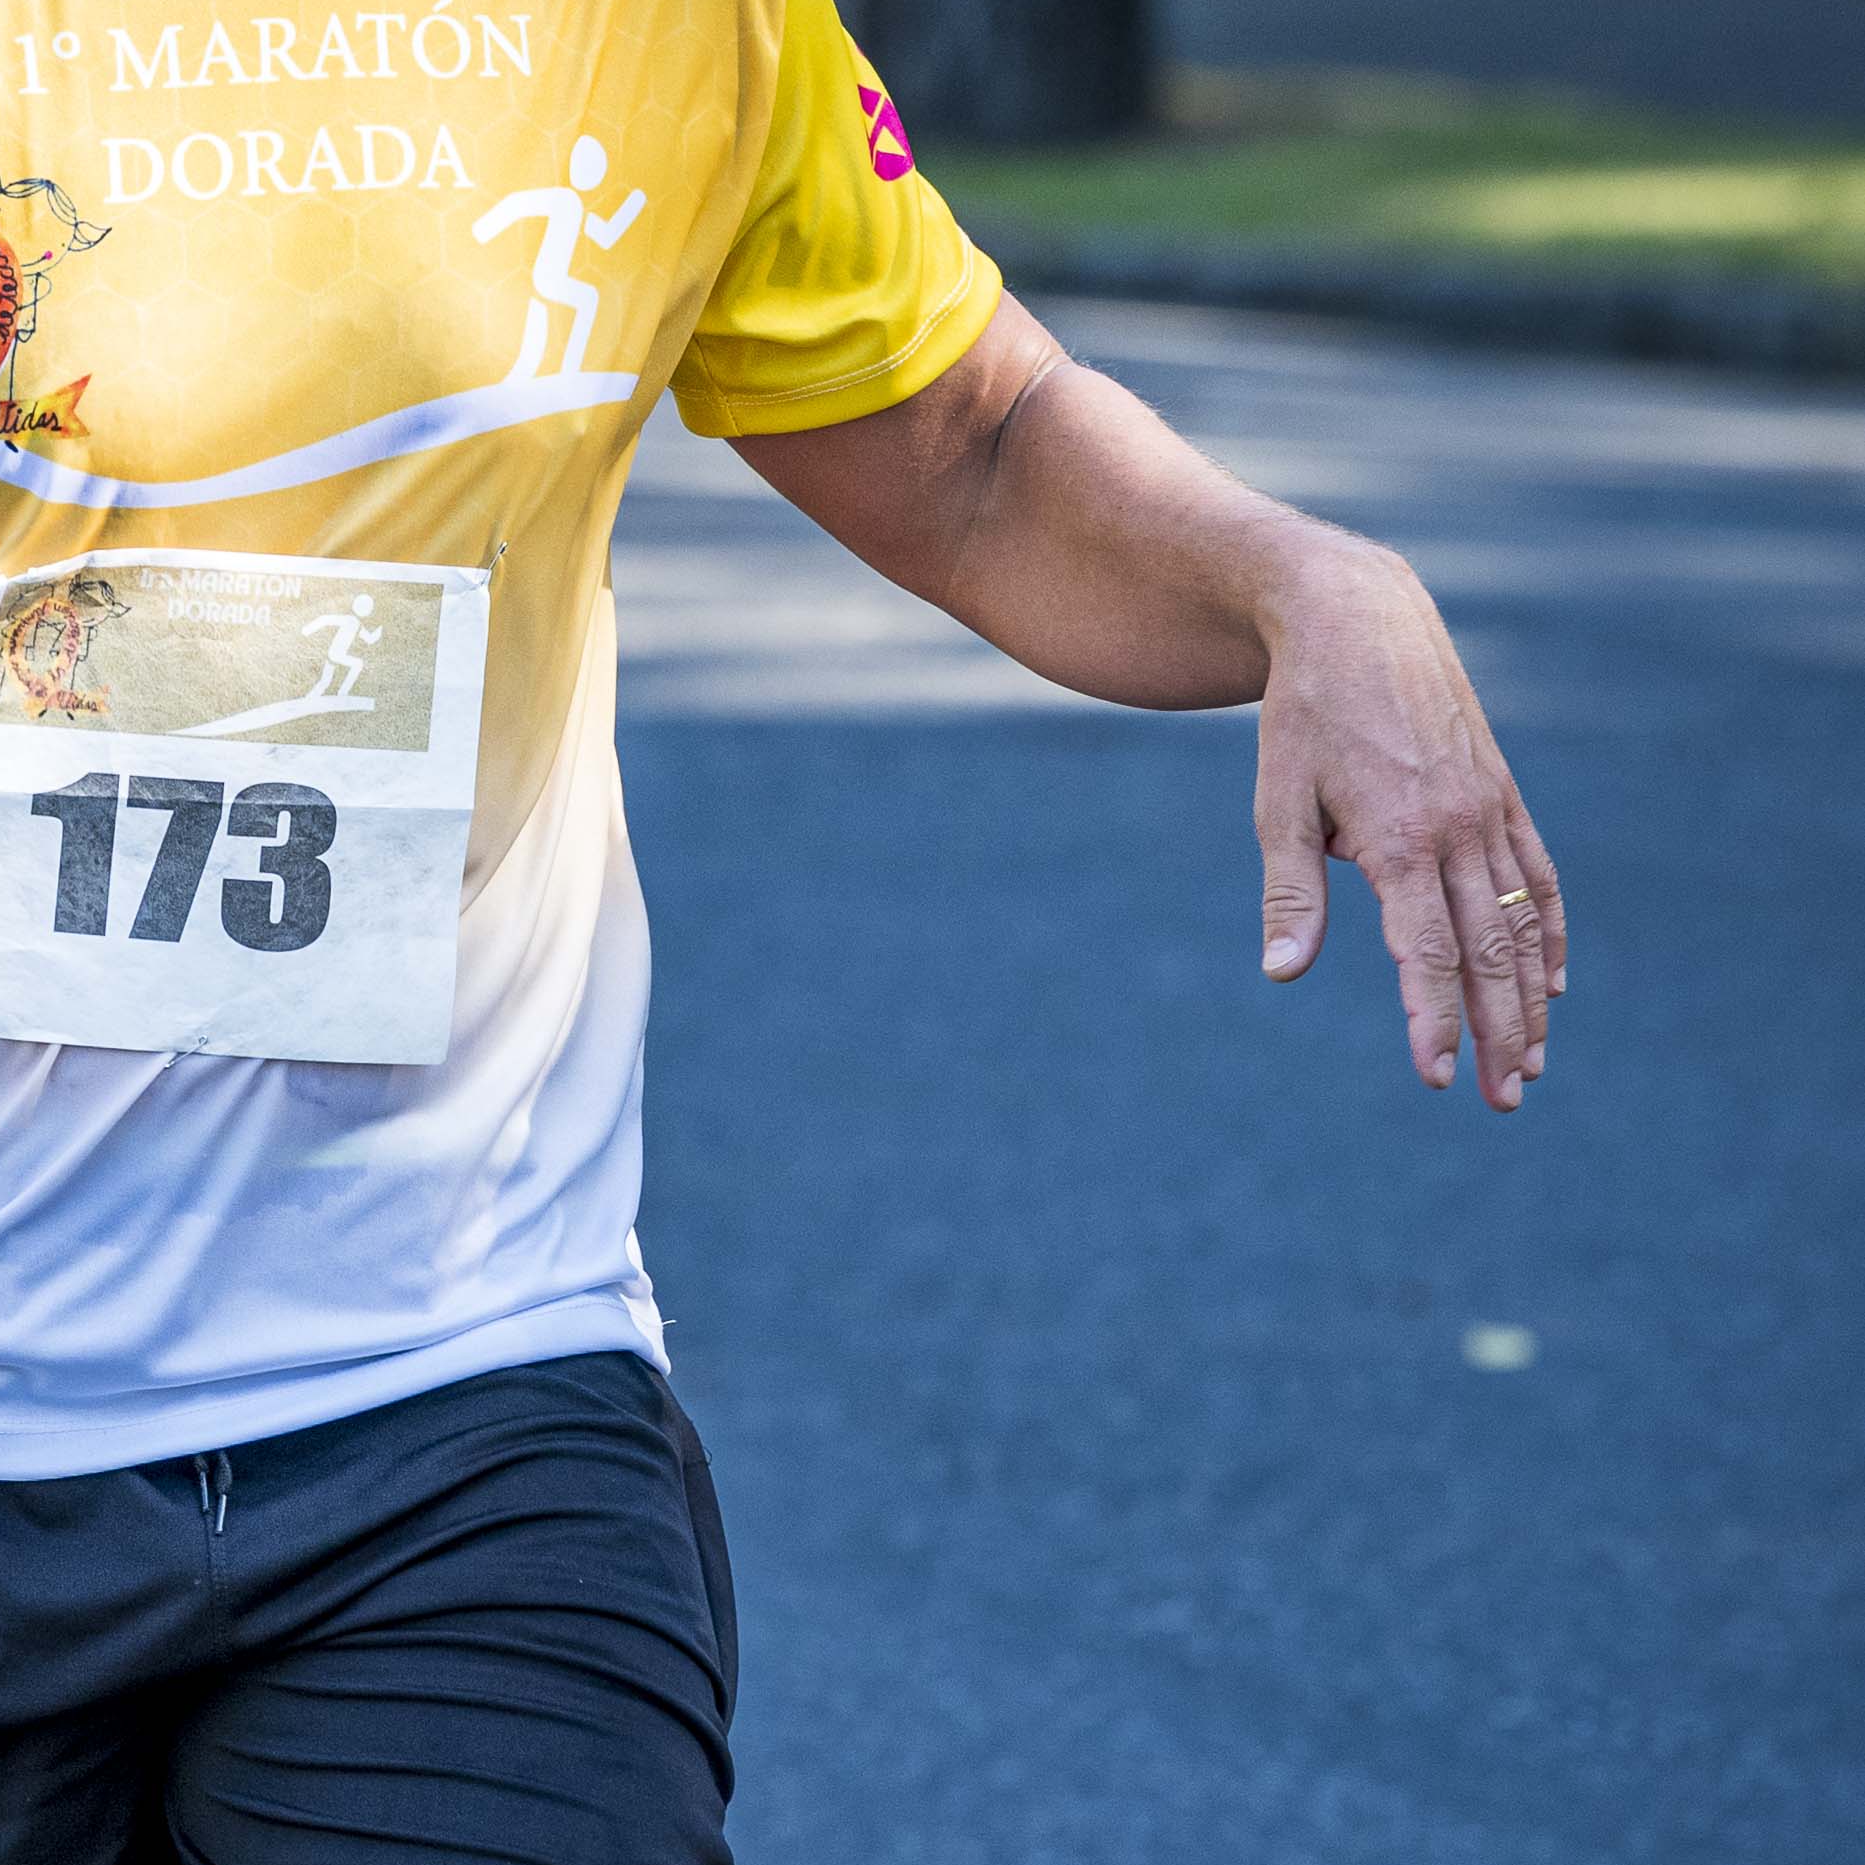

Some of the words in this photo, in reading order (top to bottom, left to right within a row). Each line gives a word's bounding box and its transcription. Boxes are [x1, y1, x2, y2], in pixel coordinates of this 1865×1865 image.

[102, 124, 474, 205] DORADA
[168, 596, 271, 626] DORADA
[30, 772, 337, 952] 173
